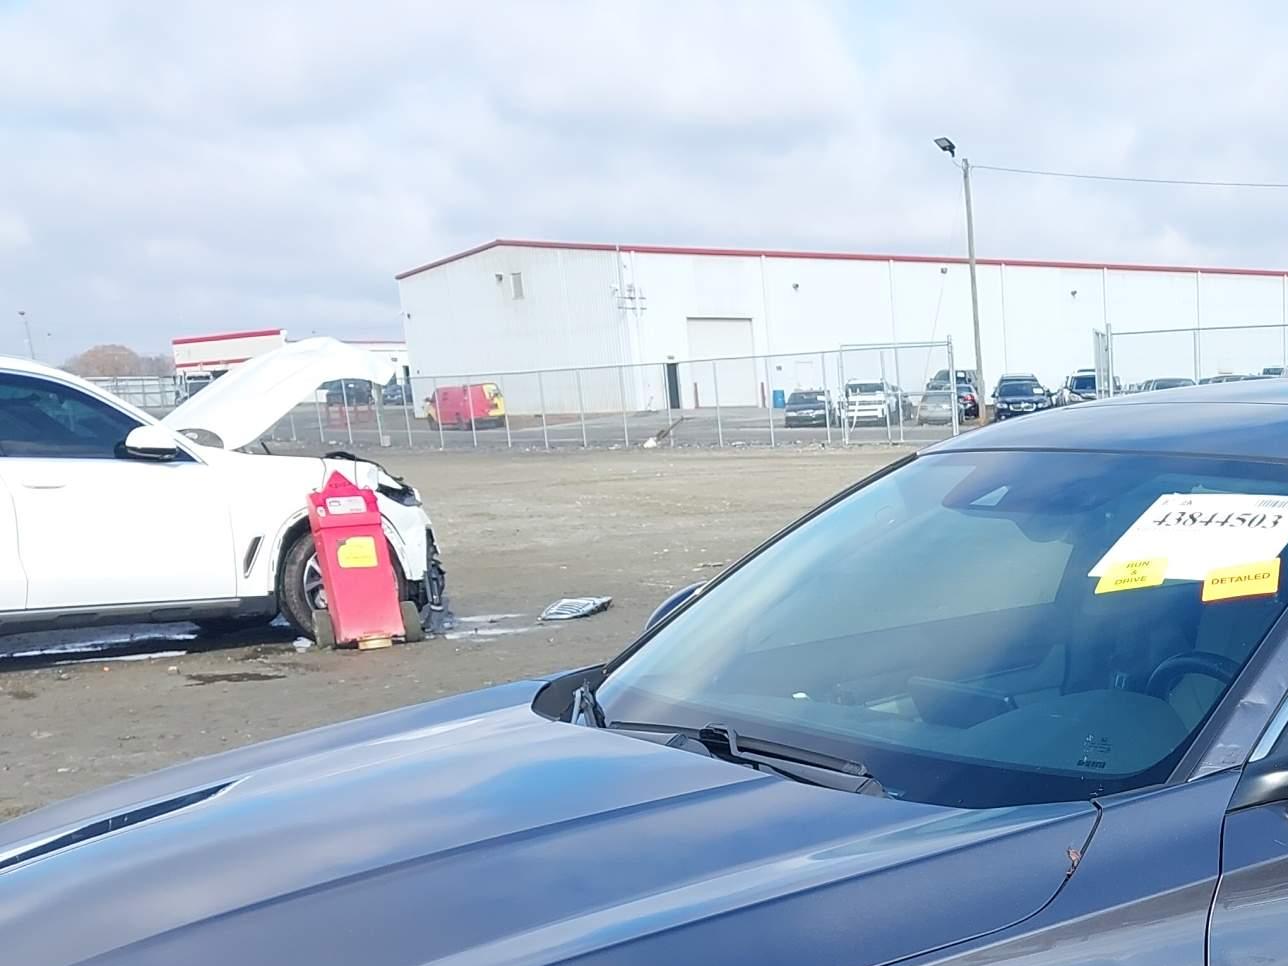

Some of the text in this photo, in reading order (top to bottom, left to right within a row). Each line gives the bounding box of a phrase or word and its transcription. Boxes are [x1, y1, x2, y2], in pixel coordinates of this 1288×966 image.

[1153, 511, 1282, 528] 43844503
[1126, 561, 1150, 569] RUN
[1114, 575, 1148, 586] DRIVE
[1211, 572, 1271, 585] DETAILED
